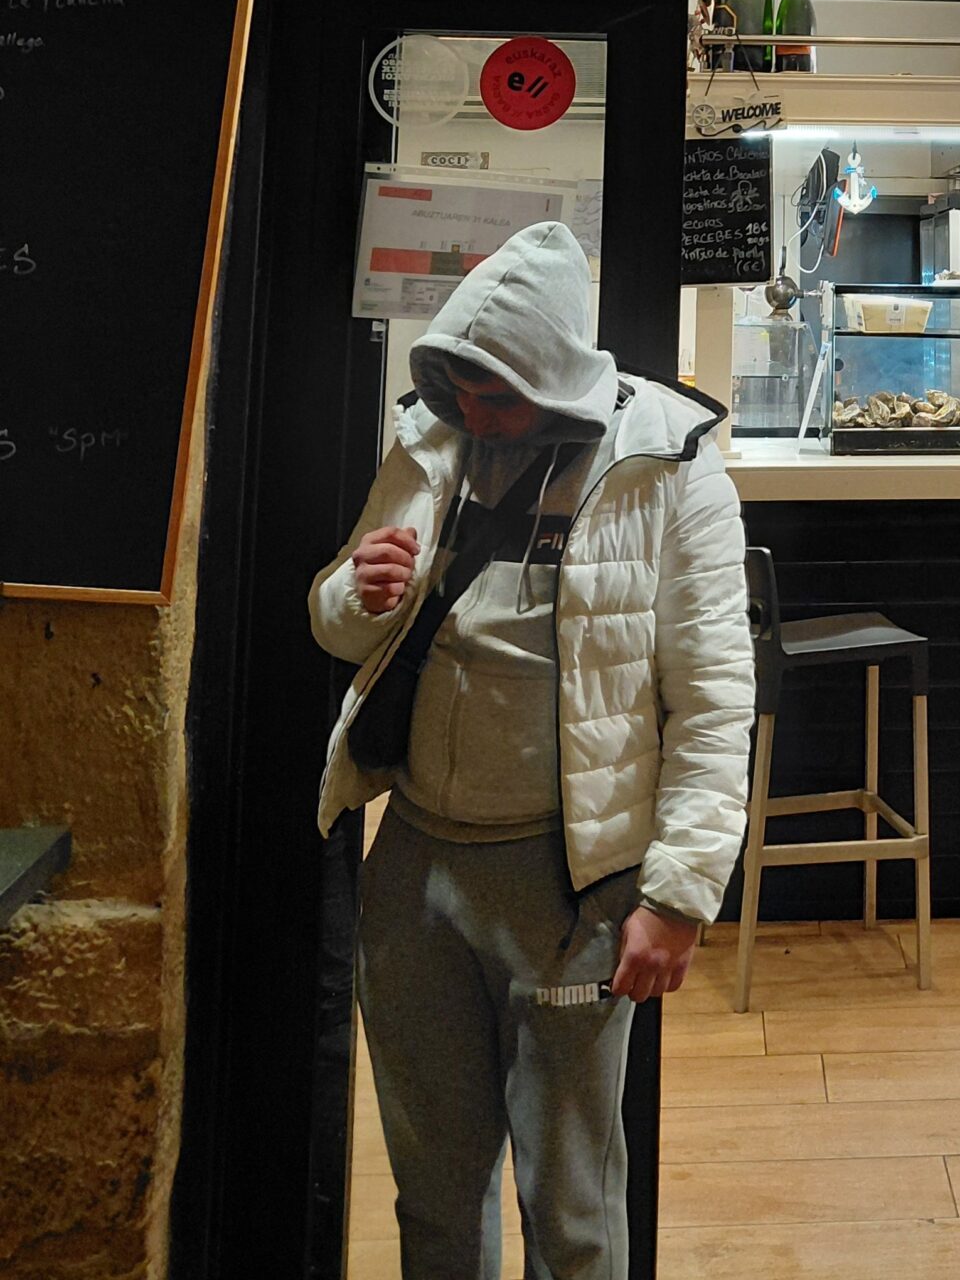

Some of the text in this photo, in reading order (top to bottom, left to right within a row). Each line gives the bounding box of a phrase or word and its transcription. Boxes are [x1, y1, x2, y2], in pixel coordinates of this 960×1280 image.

[505, 48, 562, 79] euskaraz
[721, 102, 782, 123] WELCOME
[713, 168, 729, 180] de
[712, 184, 728, 195] de
[715, 247, 729, 258] de
[536, 982, 599, 1007] PUMA
